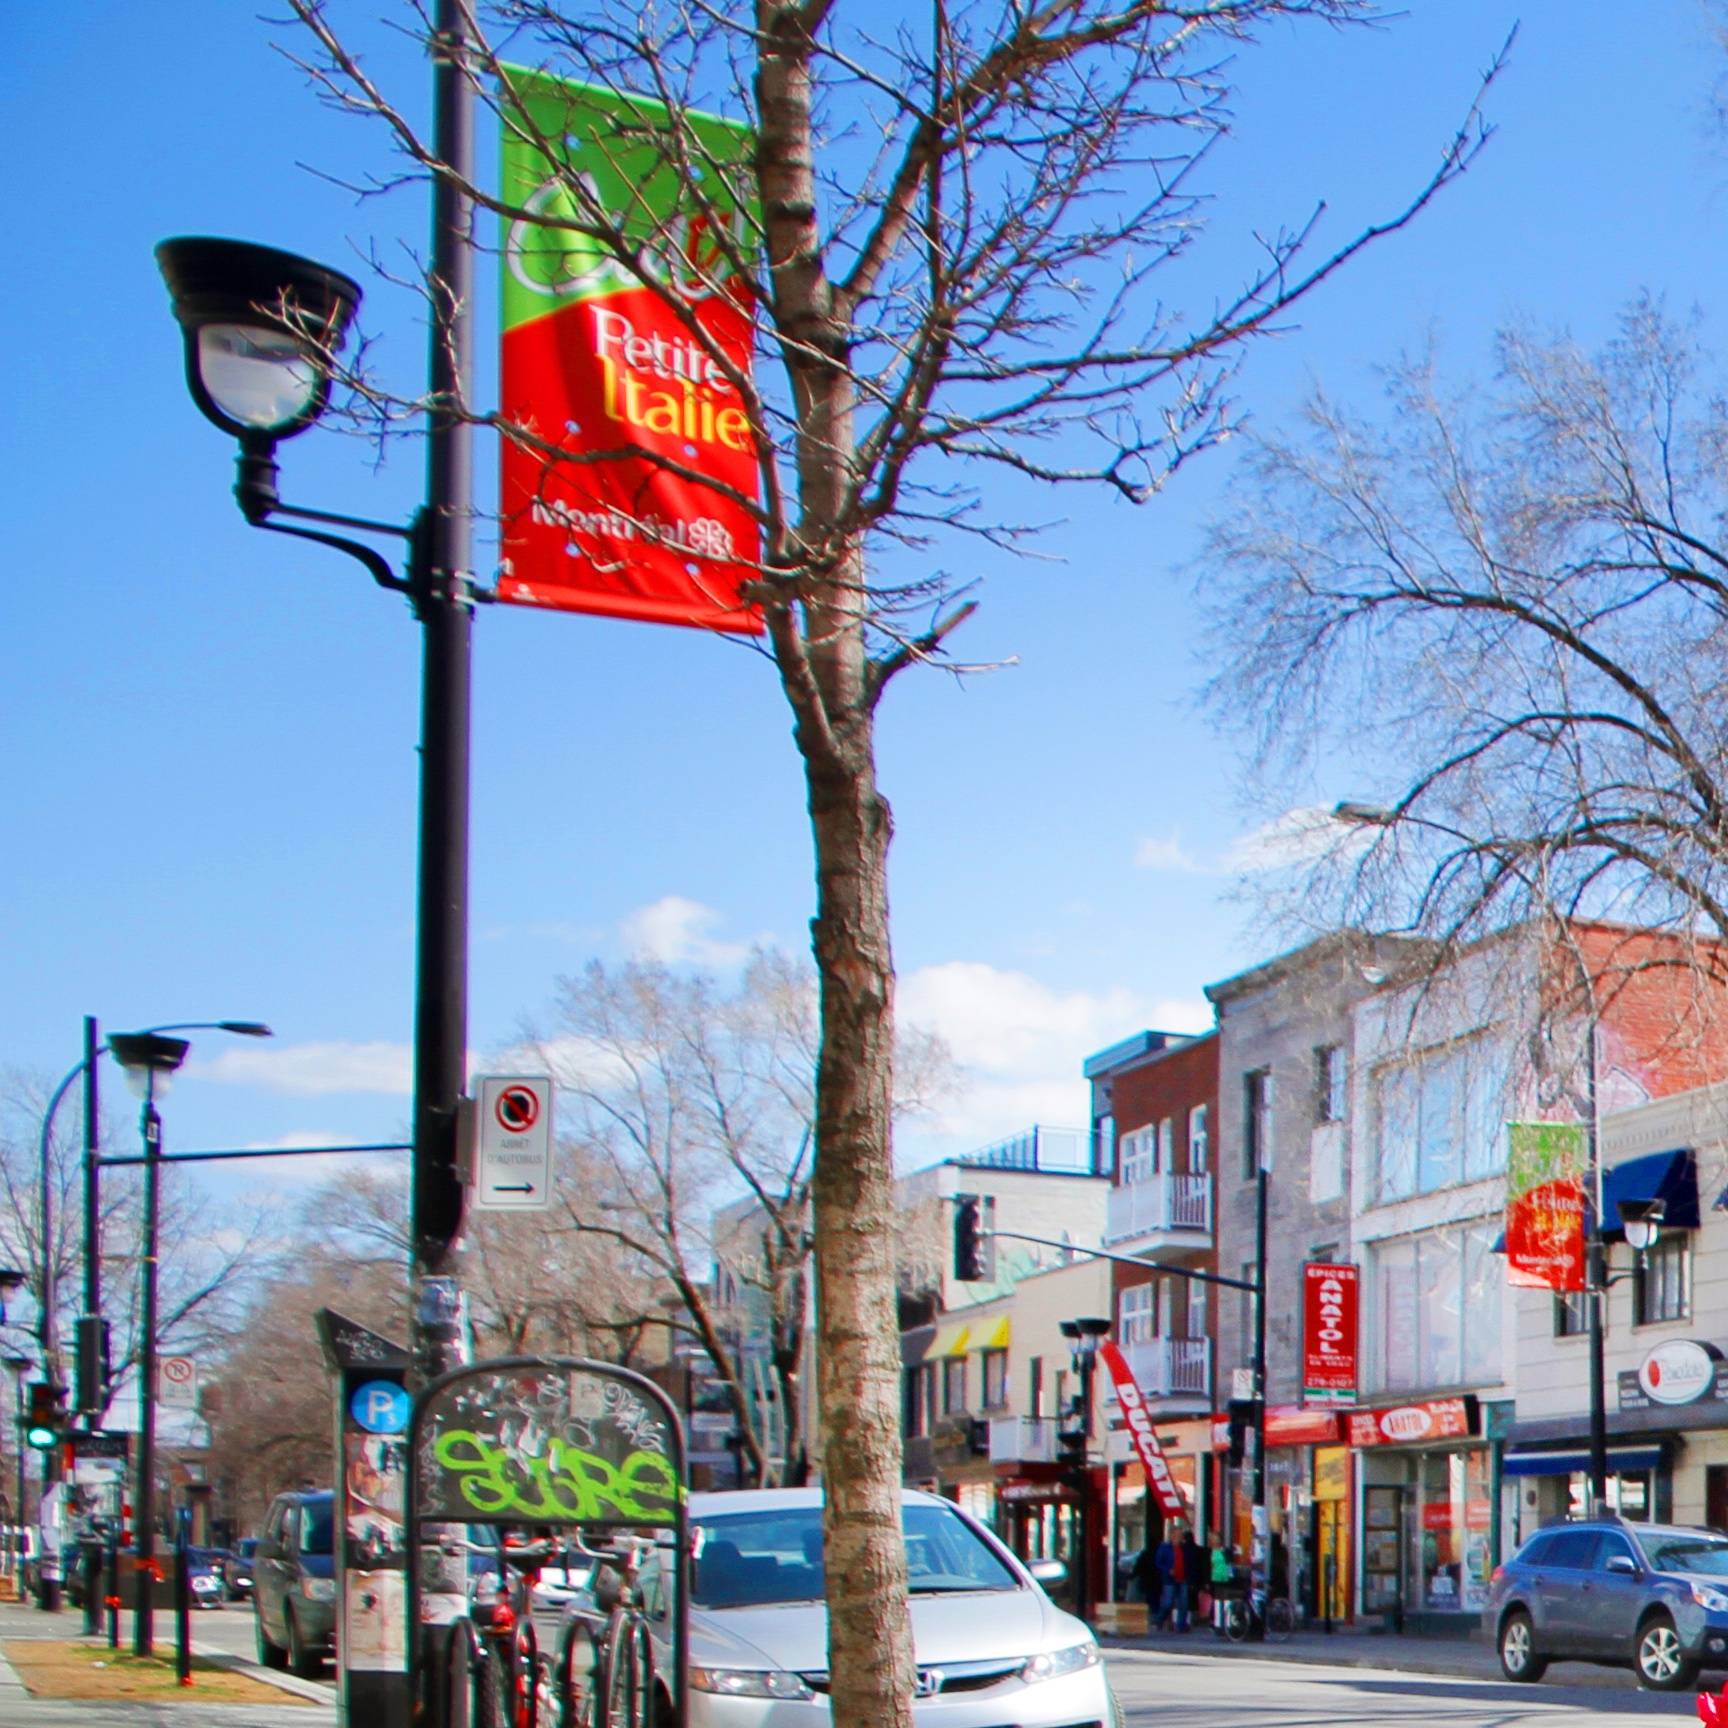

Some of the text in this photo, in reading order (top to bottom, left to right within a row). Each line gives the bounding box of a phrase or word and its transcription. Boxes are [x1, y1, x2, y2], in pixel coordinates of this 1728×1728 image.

[589, 303, 732, 394] Petite
[596, 354, 750, 449] Italie
[1317, 1279, 1344, 1354] ANATOL
[1117, 1382, 1181, 1509] DUCATI
